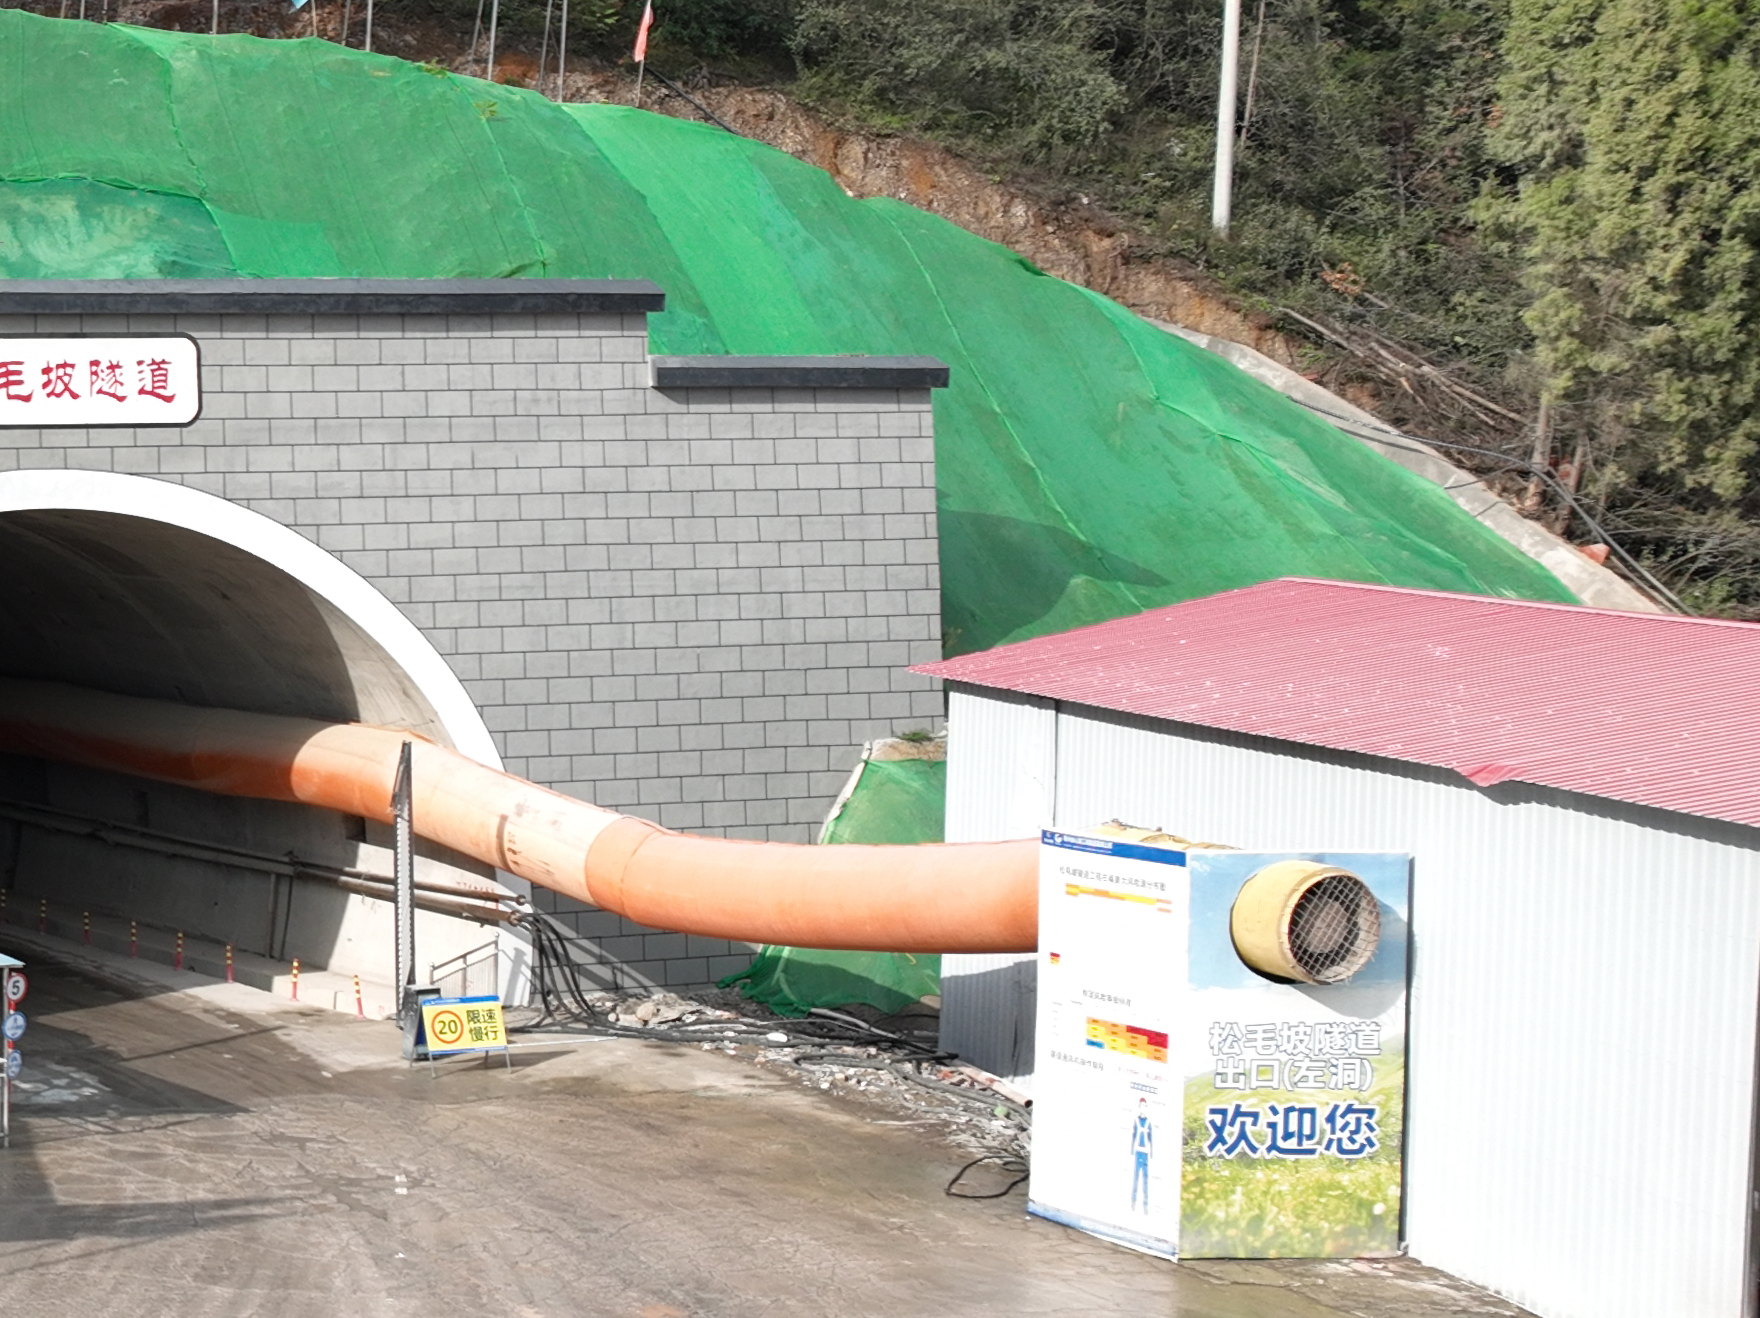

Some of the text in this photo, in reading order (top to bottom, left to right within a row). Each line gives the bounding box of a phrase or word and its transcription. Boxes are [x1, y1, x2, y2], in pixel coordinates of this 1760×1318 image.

[11, 980, 20, 996] 5
[466, 1008, 498, 1025] 限速
[437, 1019, 458, 1035] 20
[468, 1025, 499, 1042] 慢行
[1209, 1022, 1382, 1056] 松毛坡隧道
[1214, 1056, 1373, 1092] 出口(左洞)
[1207, 1103, 1377, 1156] 欢迎您
